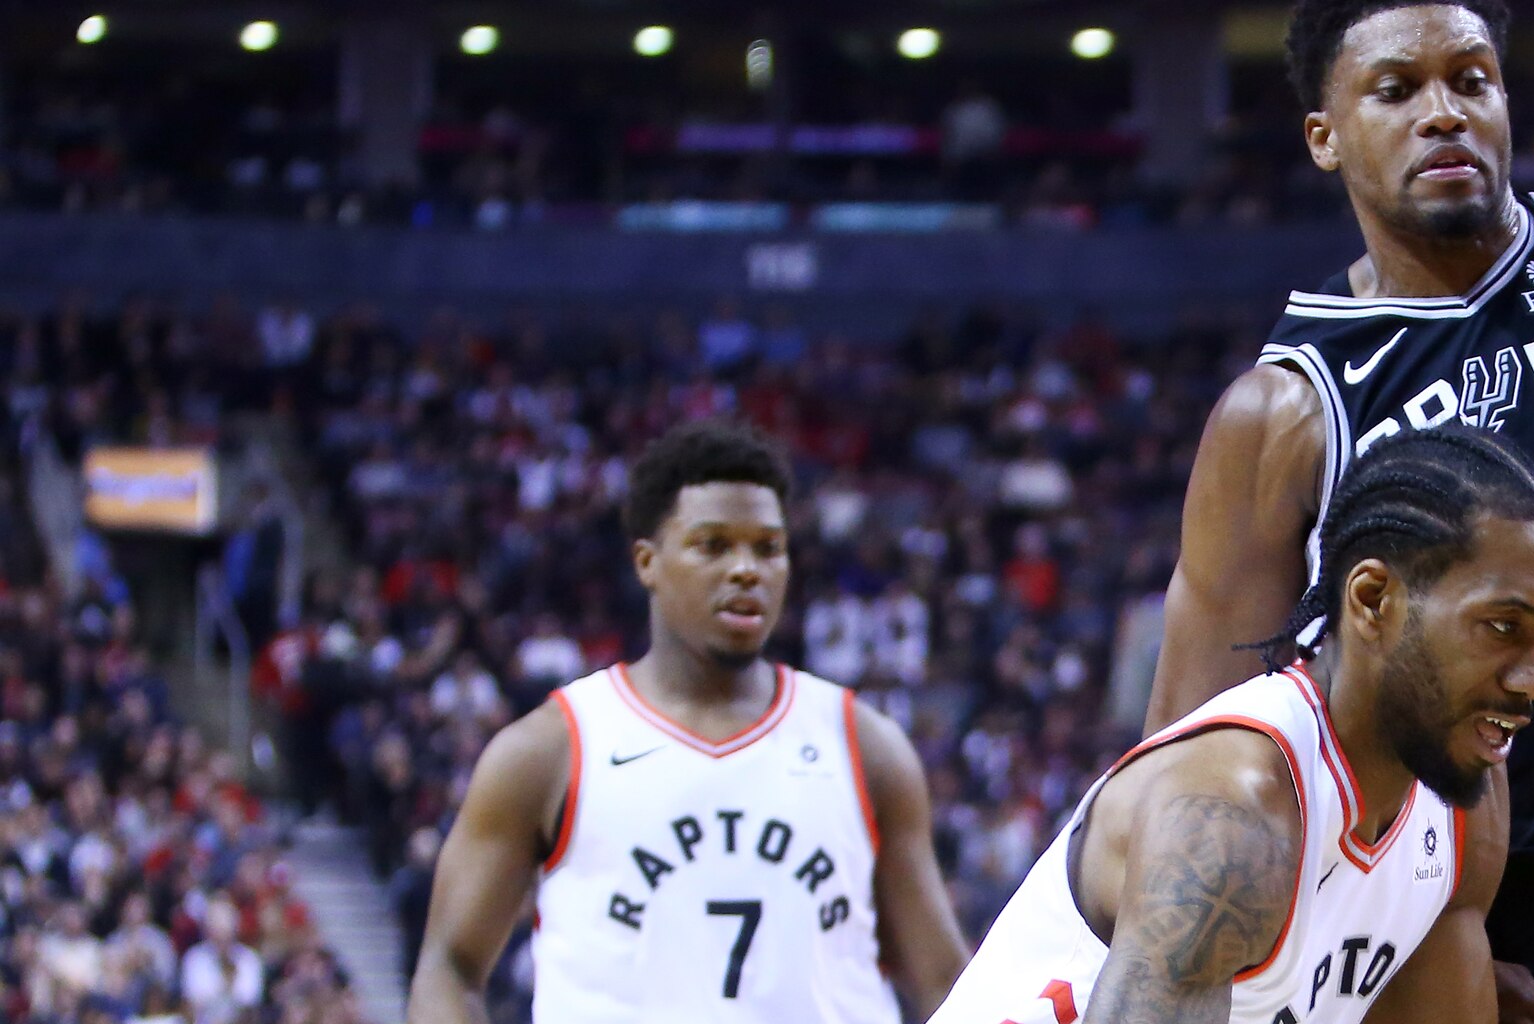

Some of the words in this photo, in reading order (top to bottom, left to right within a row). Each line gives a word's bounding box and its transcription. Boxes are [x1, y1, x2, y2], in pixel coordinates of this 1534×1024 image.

[607, 808, 851, 934] RAPTORS
[1414, 866, 1429, 881] Sun
[1430, 862, 1444, 878] Life
[705, 899, 763, 1000] 7
